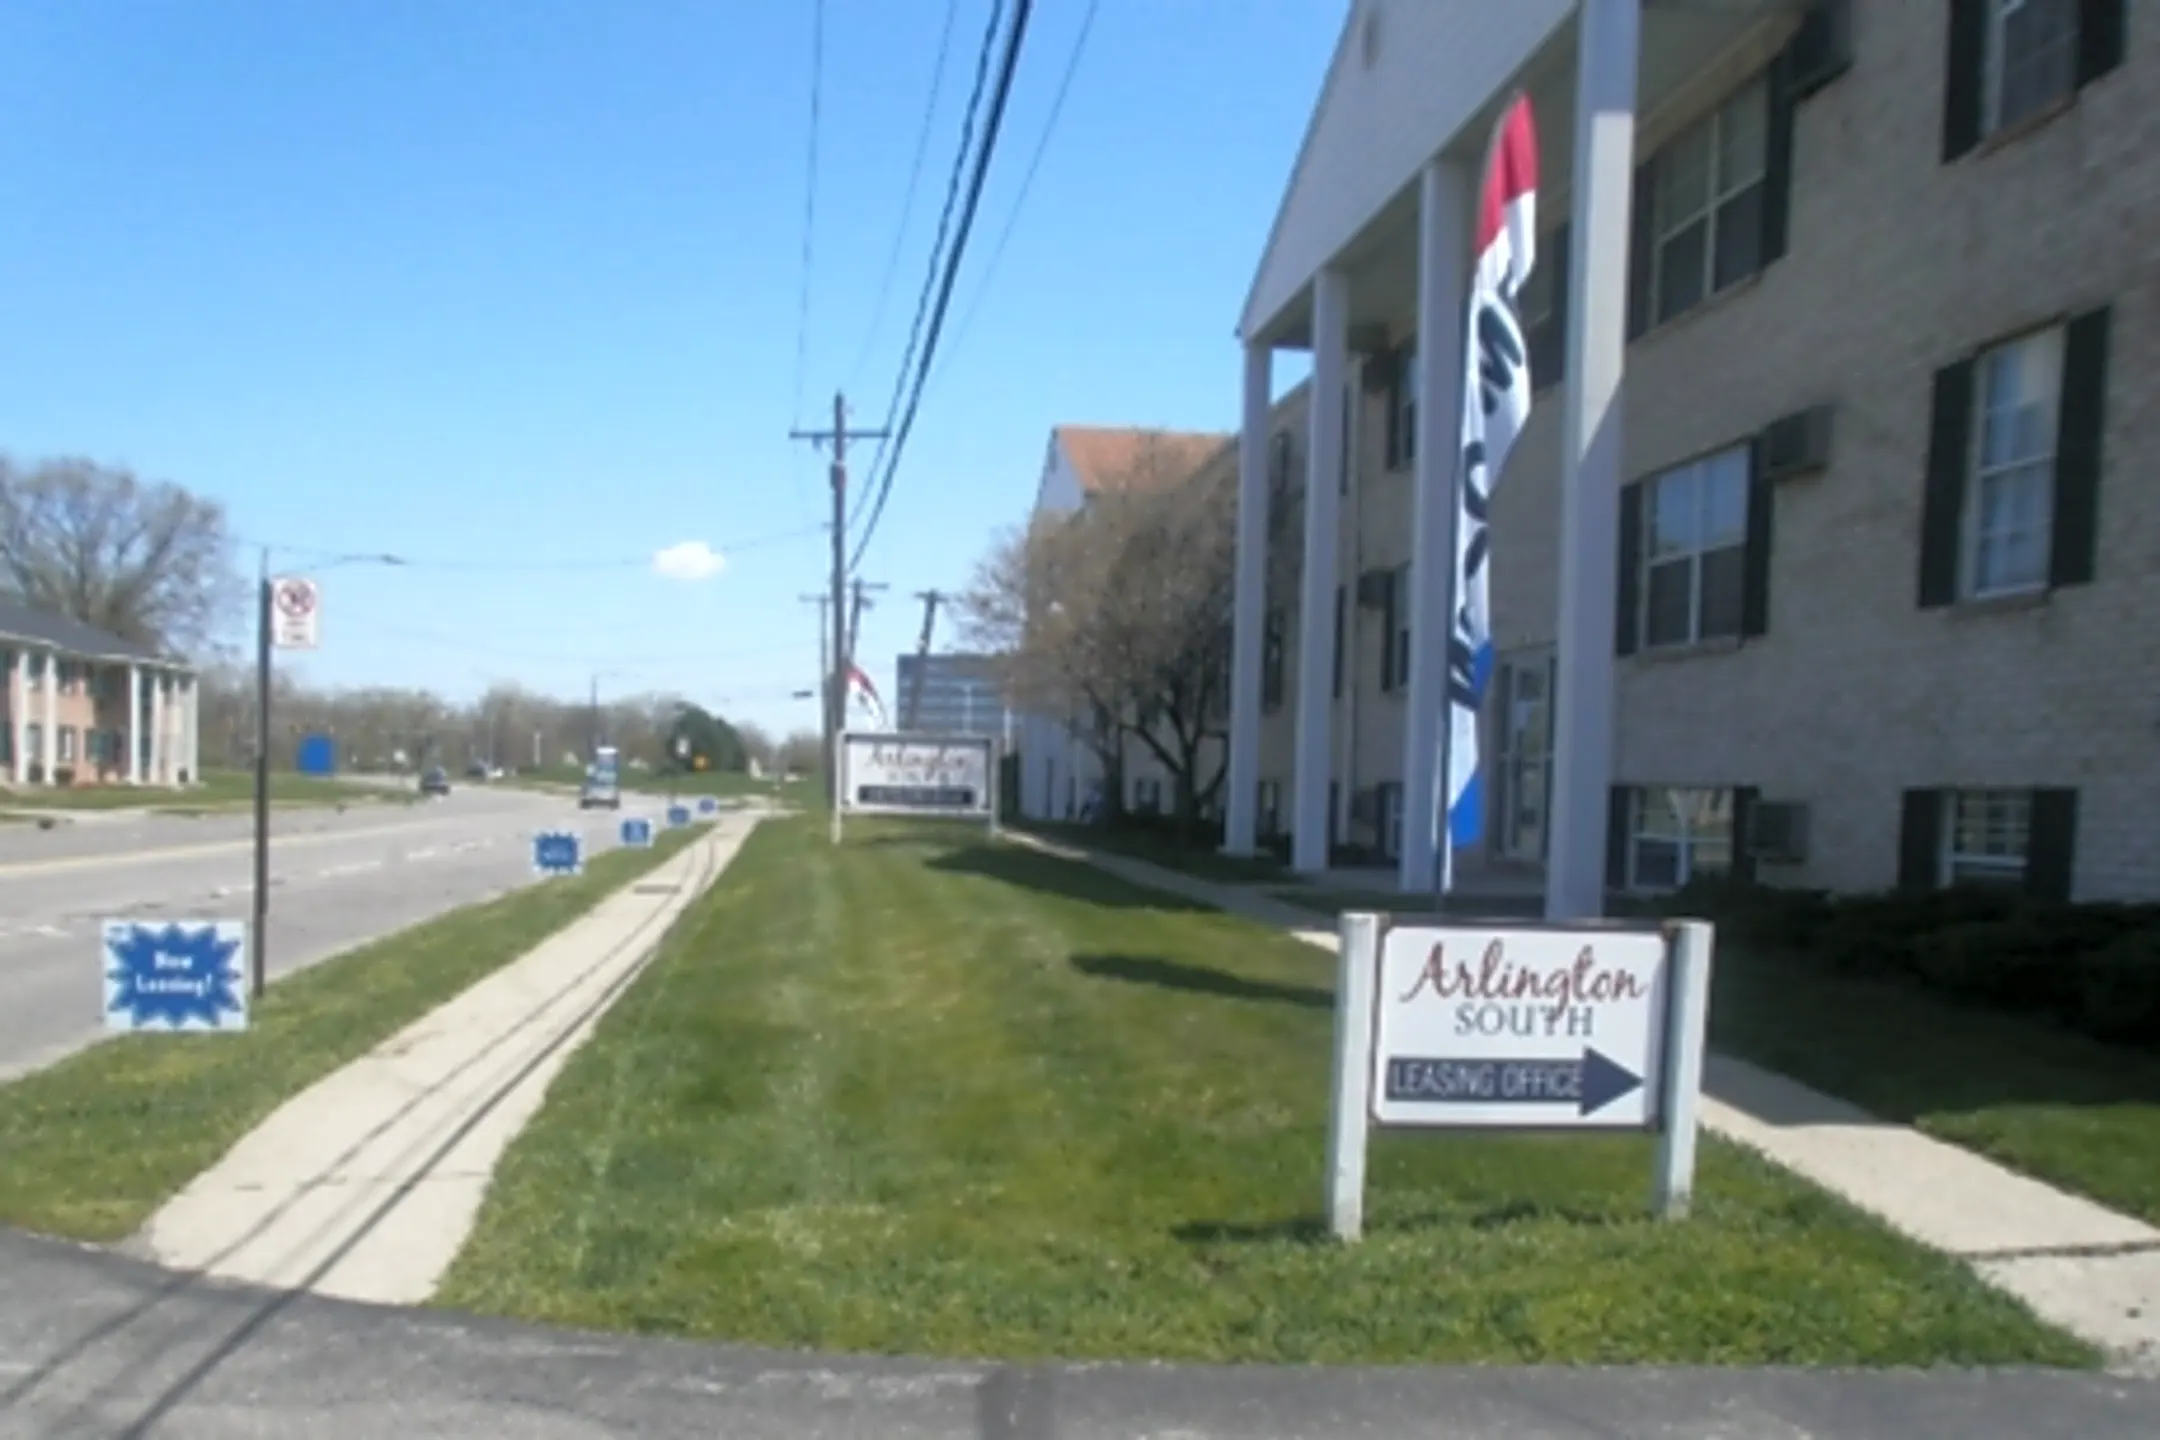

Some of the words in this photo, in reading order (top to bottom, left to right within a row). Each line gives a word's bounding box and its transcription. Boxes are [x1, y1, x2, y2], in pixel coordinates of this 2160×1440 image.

[1399, 937, 1647, 1022] Arlington
[1454, 1004, 1594, 1037] SOUTH
[1393, 1060, 1495, 1098] LEASING
[1501, 1063, 1585, 1098] OFFICE
